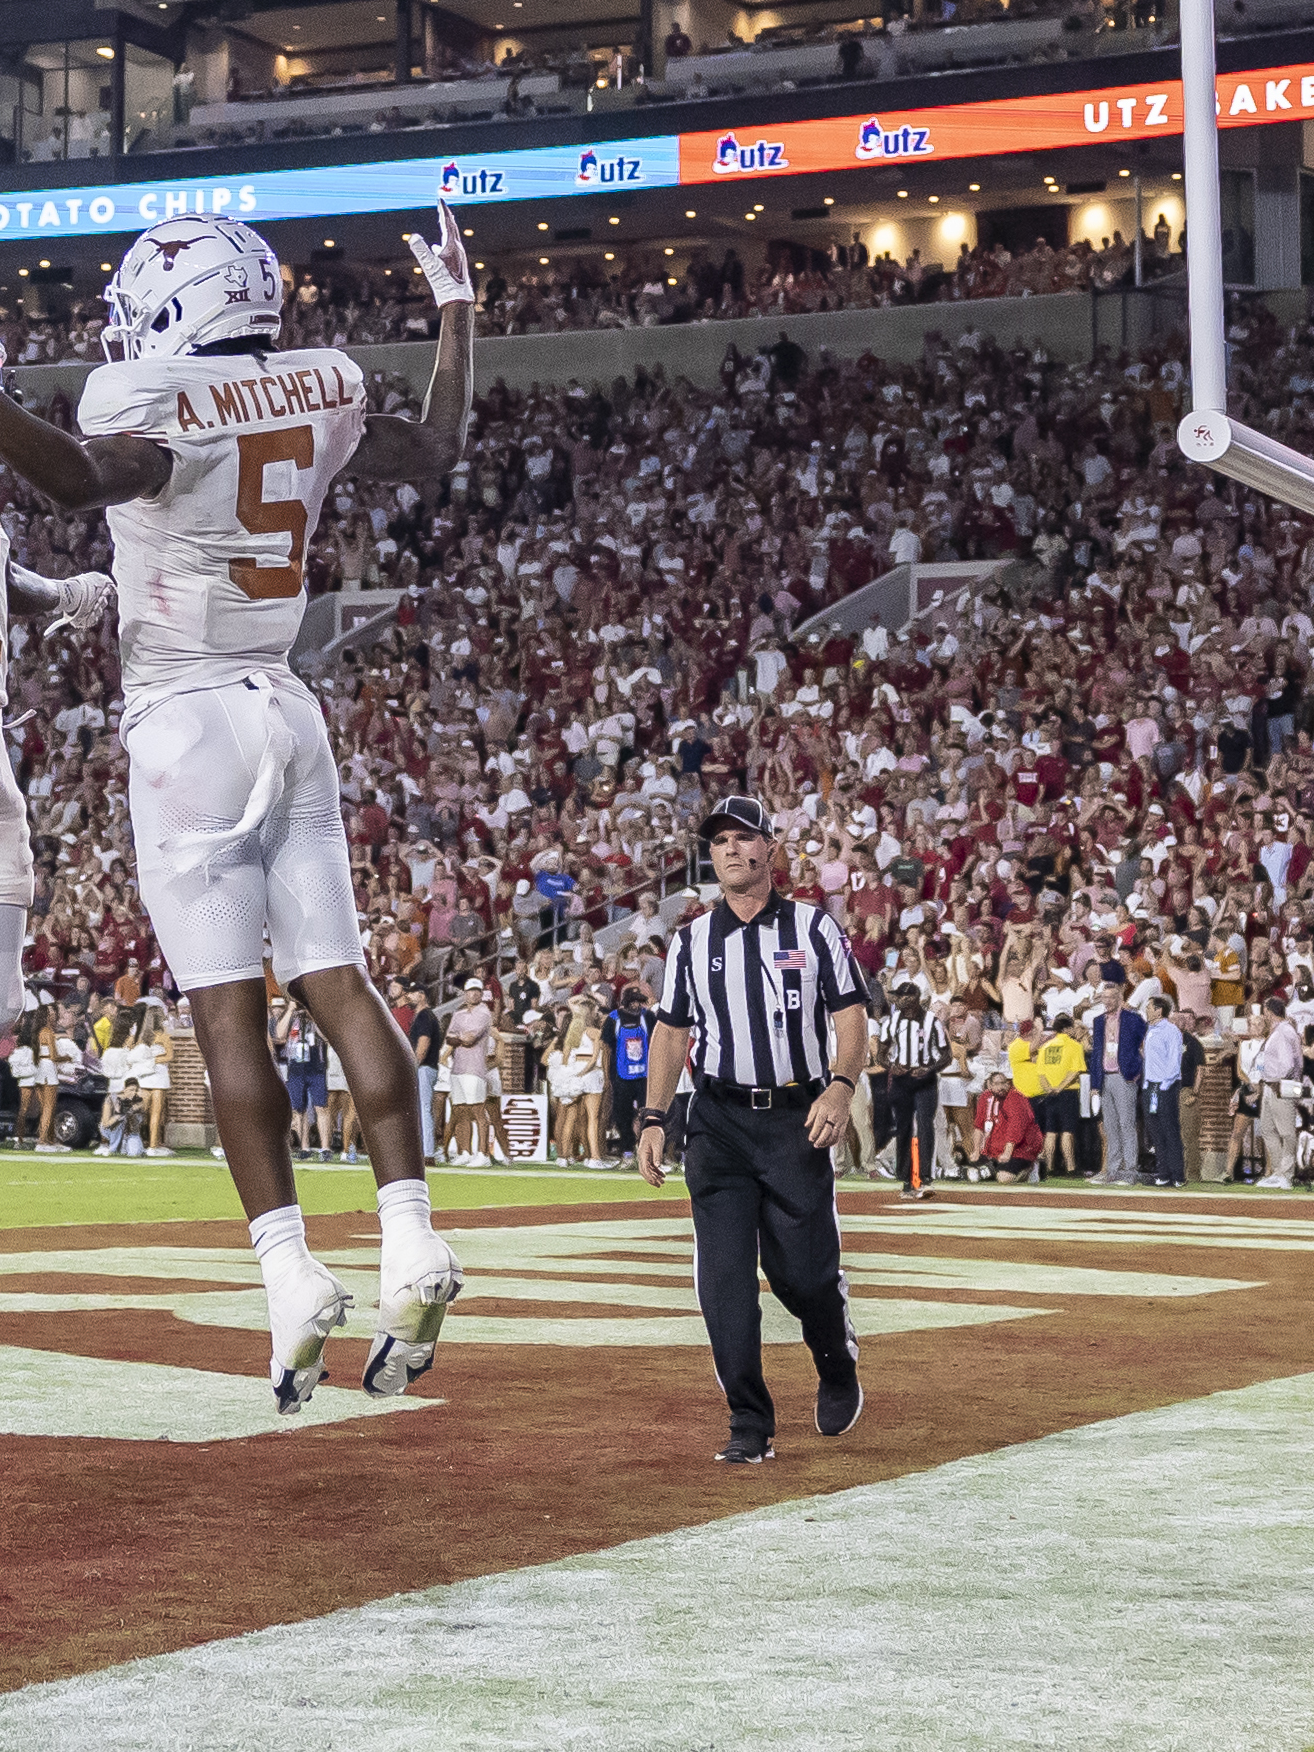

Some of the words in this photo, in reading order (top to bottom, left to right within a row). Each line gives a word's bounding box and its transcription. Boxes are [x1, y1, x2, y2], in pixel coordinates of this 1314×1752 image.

[1083, 94, 1168, 133] UTZ
[1215, 76, 1314, 116] AKE
[138, 185, 257, 220] CHIPS
[259, 258, 276, 301] 5
[208, 366, 353, 426] MITCHELL
[228, 424, 315, 599] 5
[711, 957, 723, 971] S
[787, 990, 801, 1009] B
